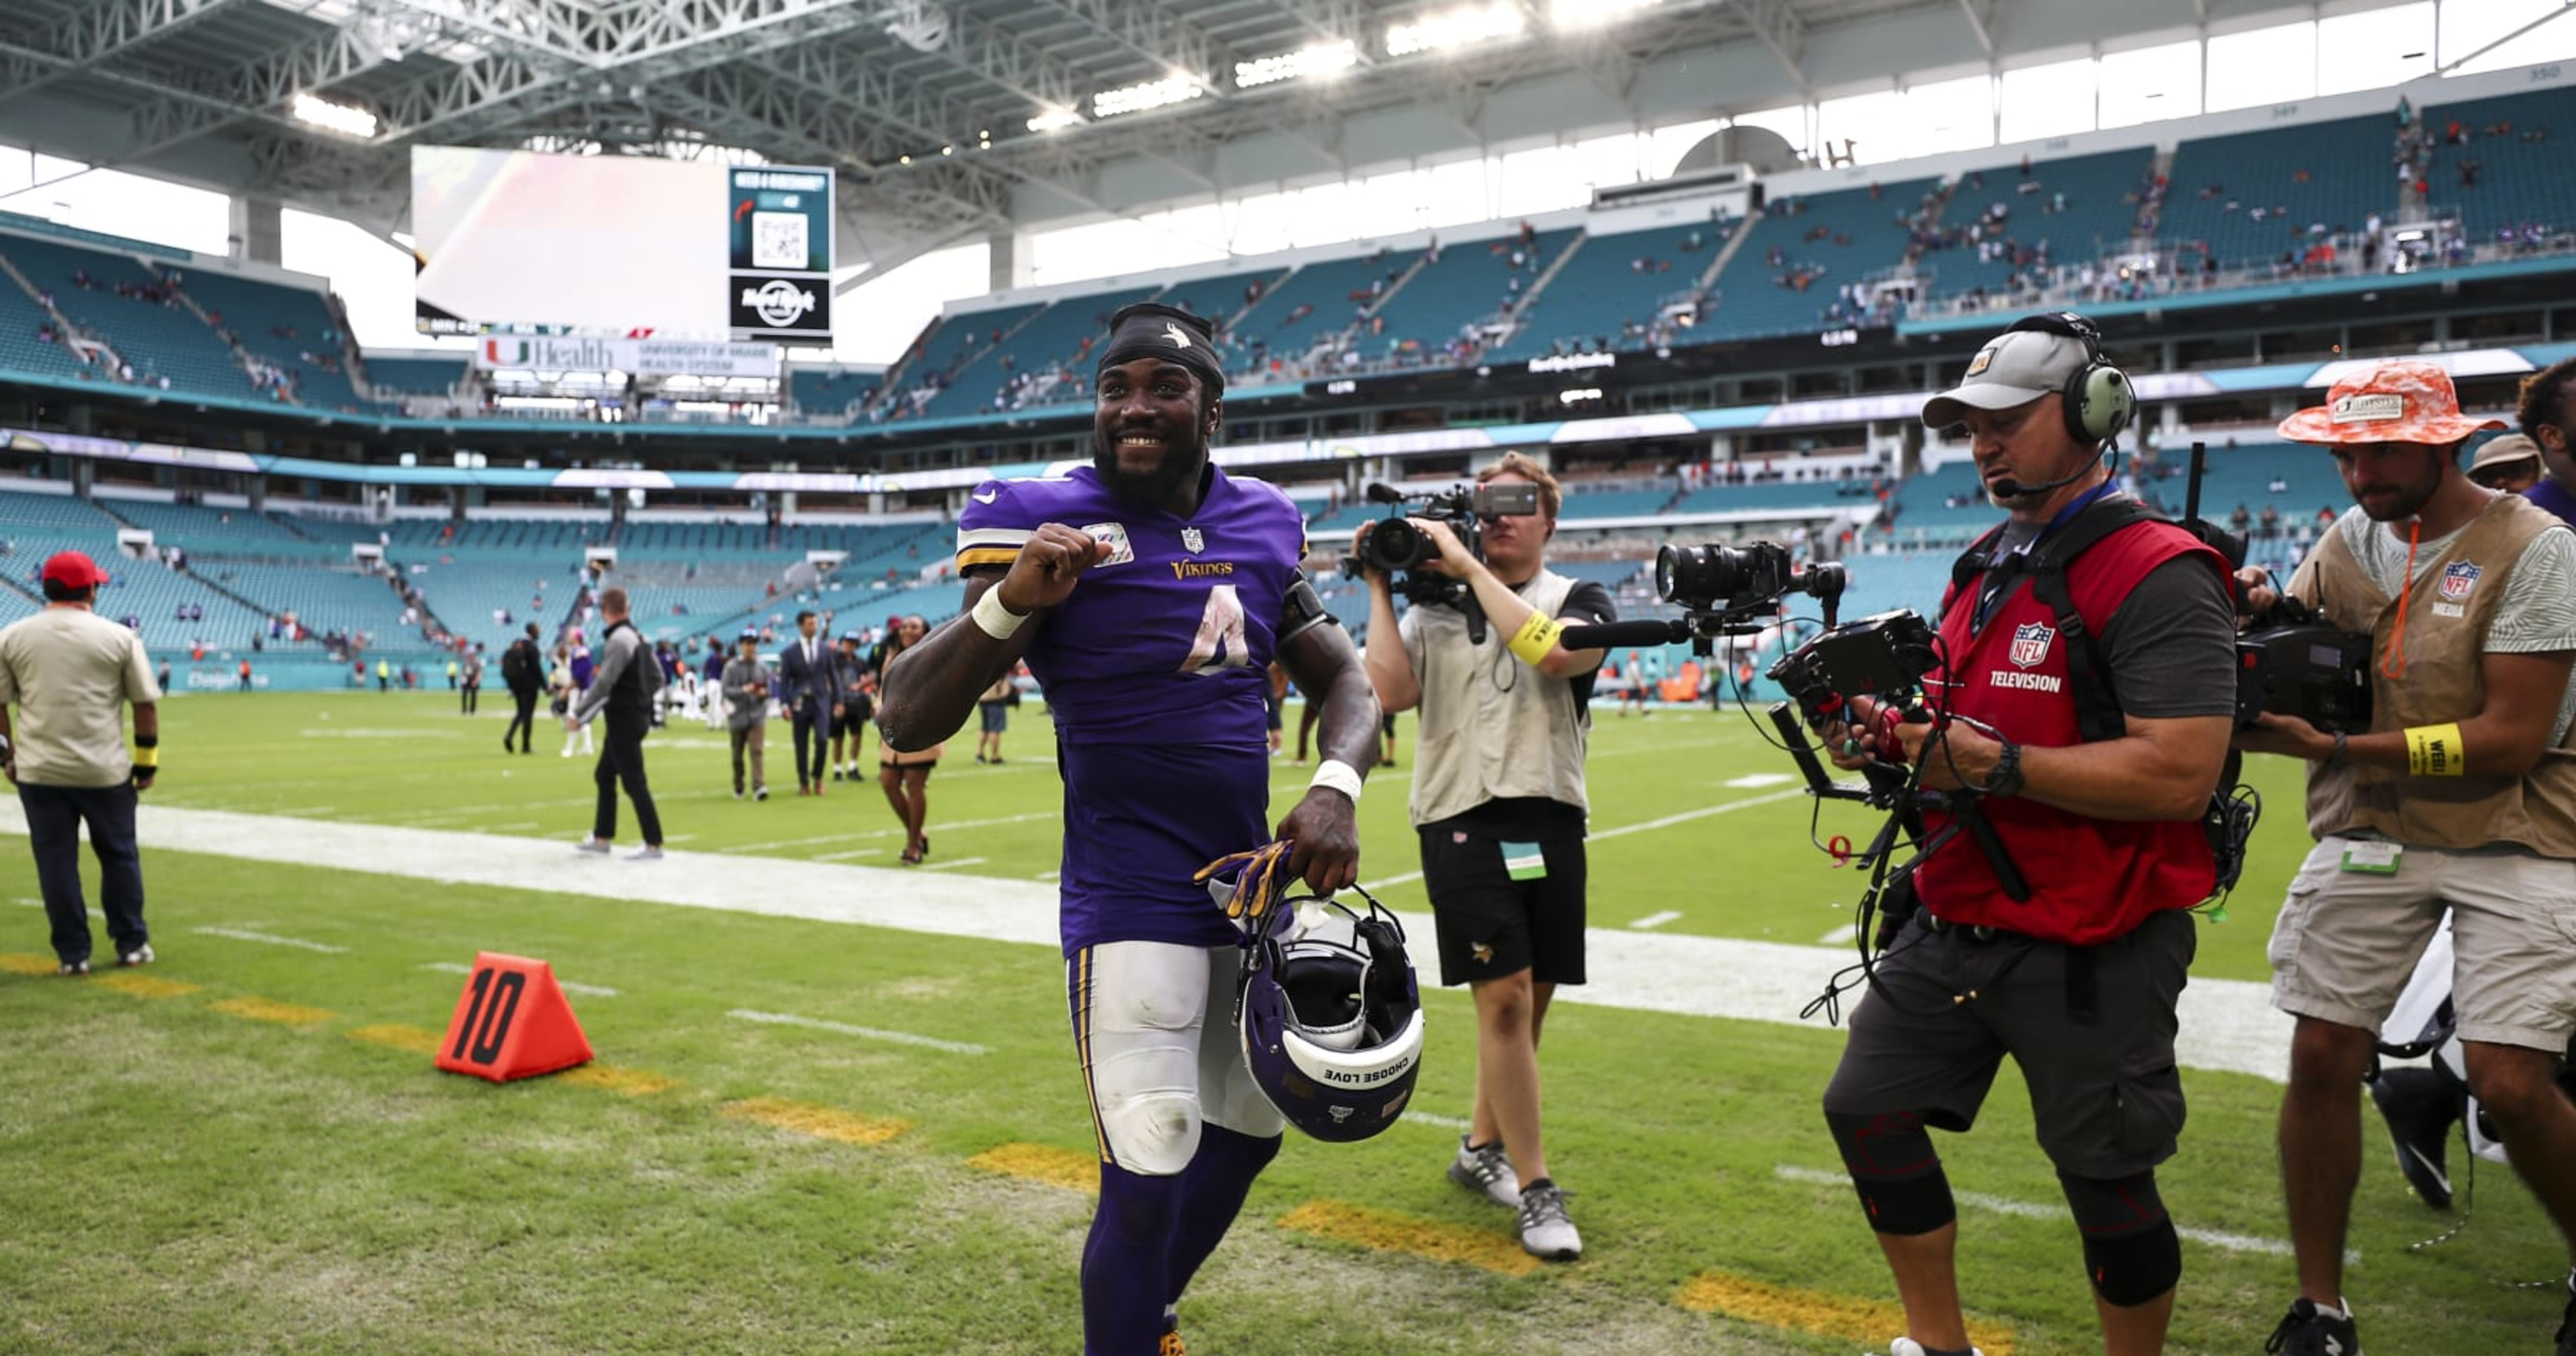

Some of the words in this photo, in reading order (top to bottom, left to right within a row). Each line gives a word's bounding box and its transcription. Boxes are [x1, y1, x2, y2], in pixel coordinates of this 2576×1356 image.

[710, 344, 725, 355] OF
[2444, 576, 2470, 595] NFL
[1178, 584, 1250, 677] 4
[2015, 641, 2040, 662] NFL
[1990, 671, 2061, 692] TELEVISION
[452, 968, 526, 1065] 10
[1323, 1069, 1361, 1083] LOVE
[1363, 1056, 1409, 1083] CHOOSE
